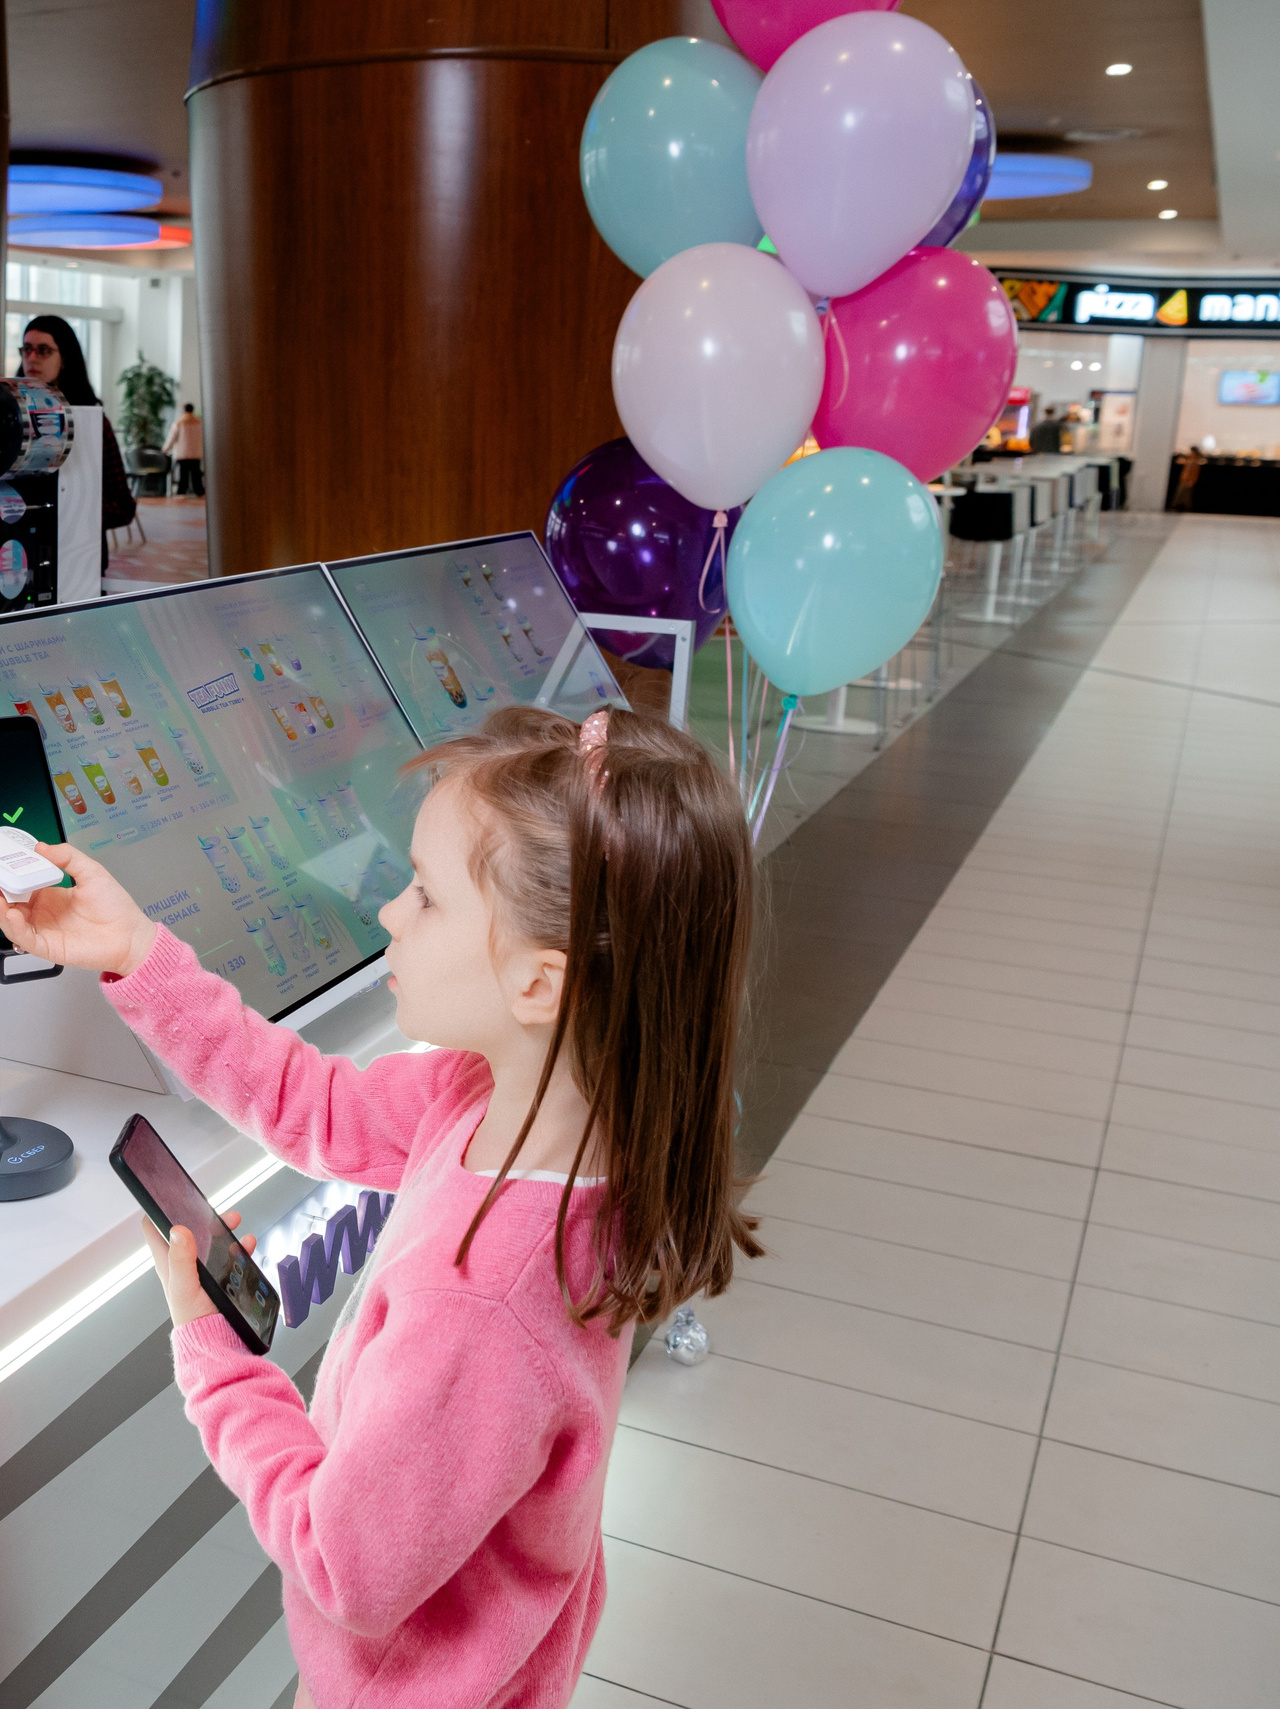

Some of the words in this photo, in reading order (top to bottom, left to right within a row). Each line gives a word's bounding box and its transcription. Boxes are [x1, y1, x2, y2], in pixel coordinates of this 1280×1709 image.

[6, 644, 14, 653] С
[14, 634, 67, 651] ШАРИКАМИ
[32, 650, 51, 661] TEA
[206, 675, 238, 701] FUNNY
[228, 954, 246, 972] 330
[20, 1144, 46, 1159] СБЕР
